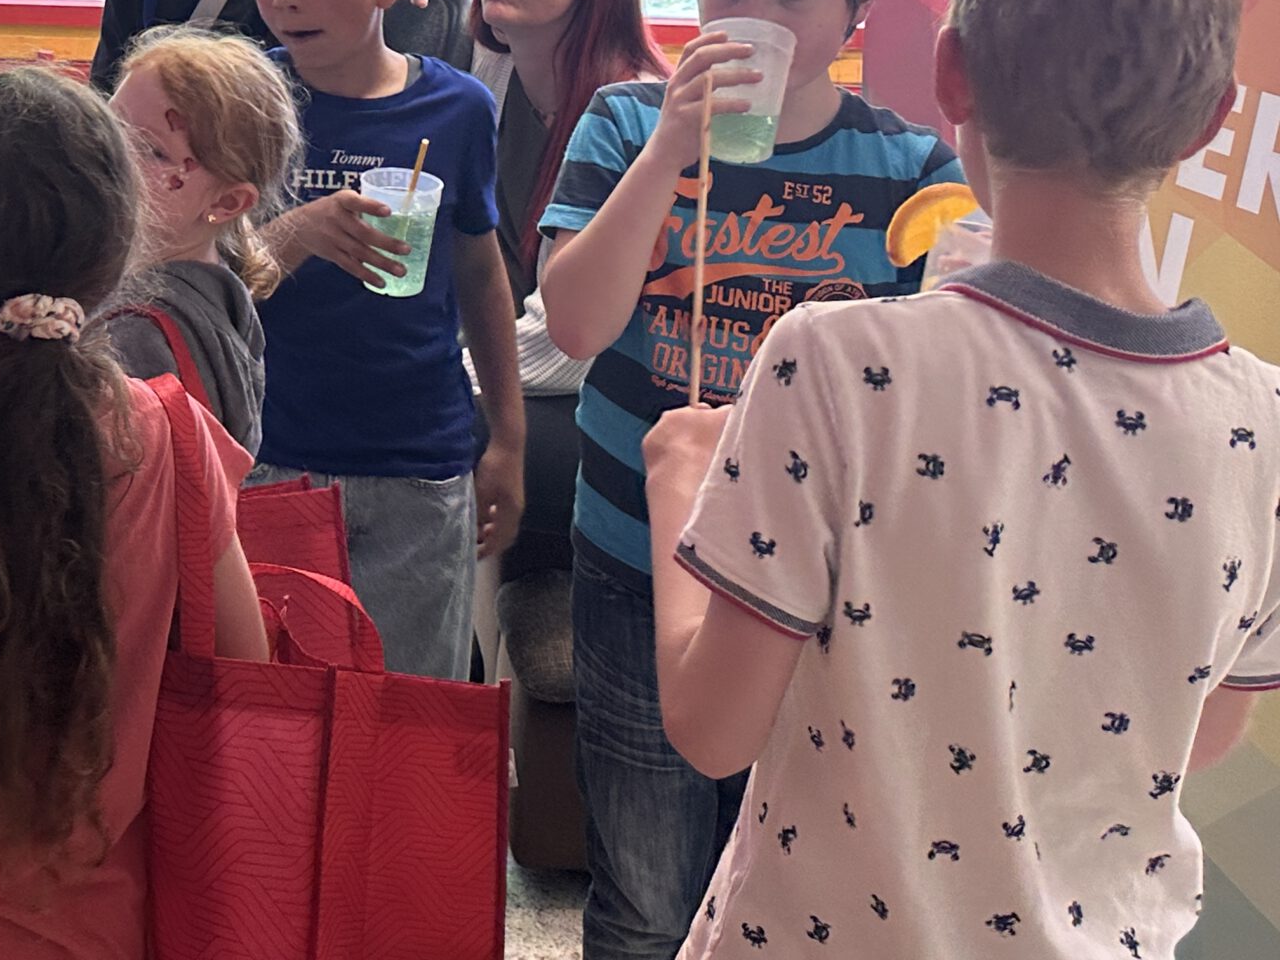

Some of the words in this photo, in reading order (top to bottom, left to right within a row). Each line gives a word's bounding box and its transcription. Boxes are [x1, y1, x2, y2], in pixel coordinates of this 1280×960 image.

[331, 149, 385, 166] Tommy
[812, 185, 833, 205] 52
[762, 278, 794, 295] THE
[705, 285, 793, 313] JUNIOR
